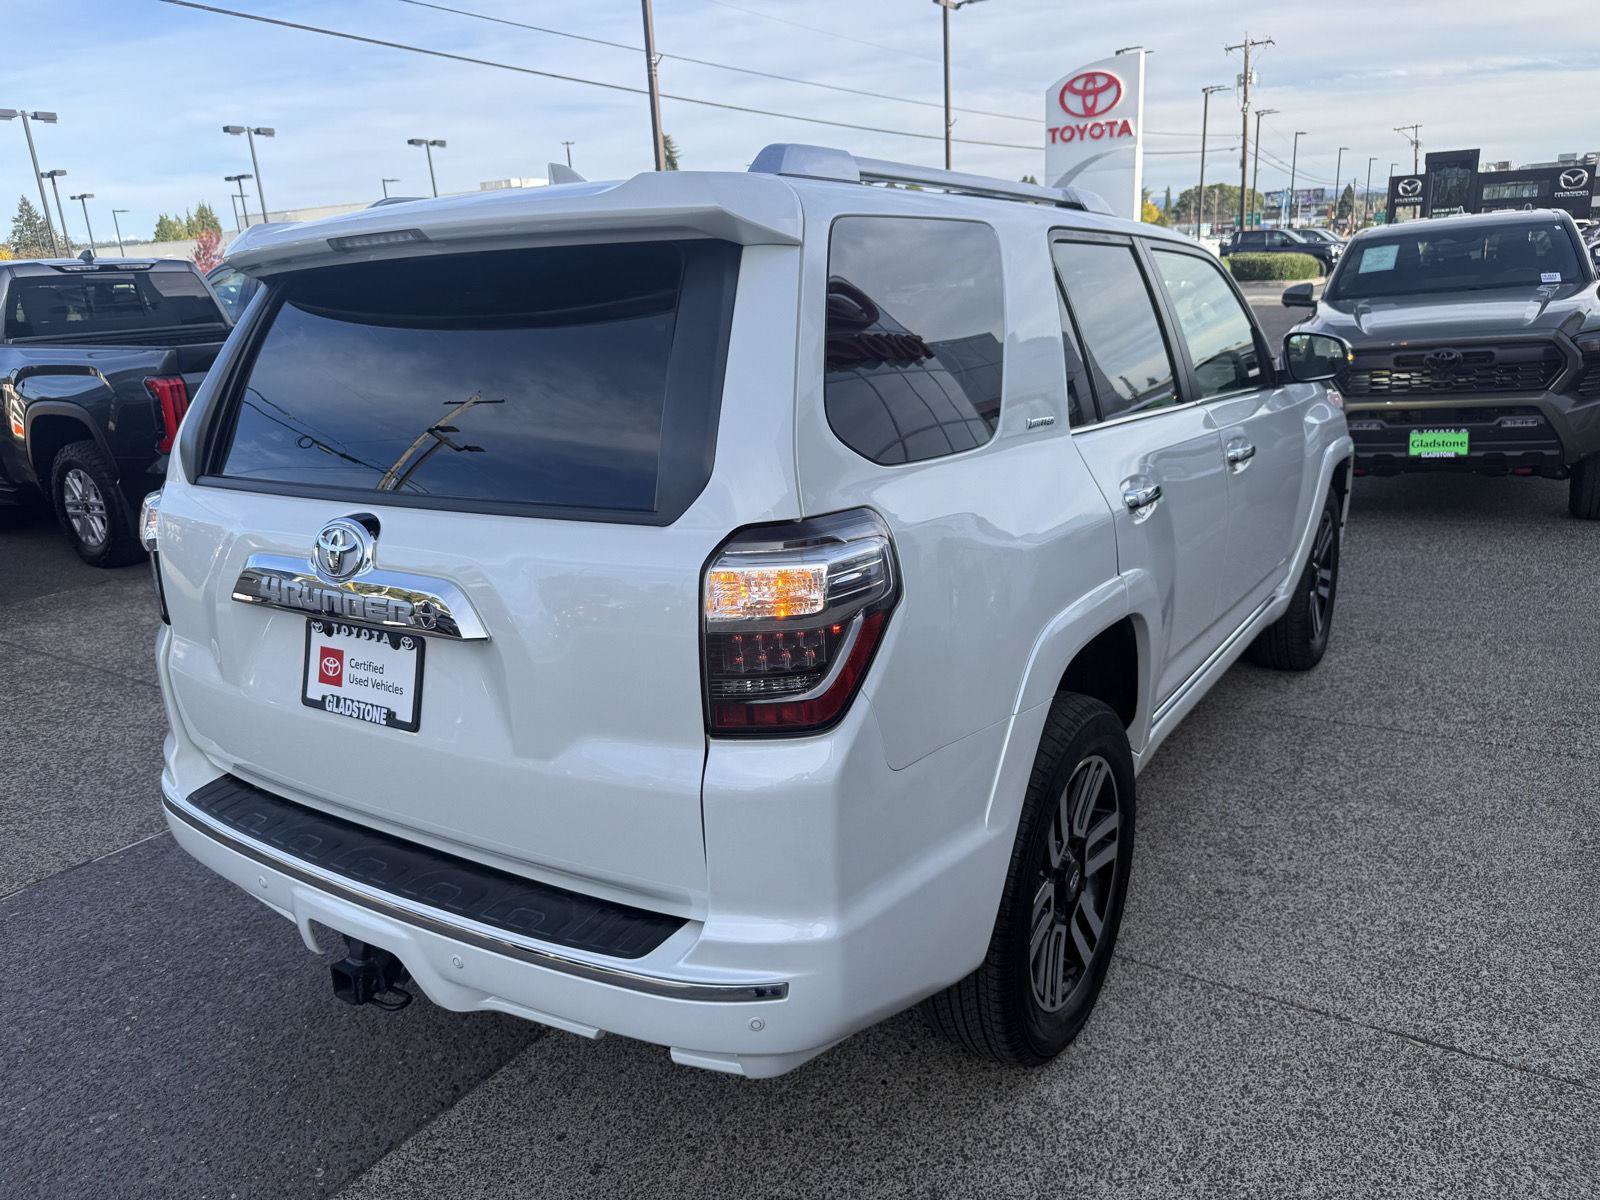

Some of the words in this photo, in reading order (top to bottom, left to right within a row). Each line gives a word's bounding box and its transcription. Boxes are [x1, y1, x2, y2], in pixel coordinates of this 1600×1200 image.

[1047, 119, 1134, 144] TOYOTA
[1411, 439, 1467, 449] Gladstone
[259, 575, 414, 625] 4RUNNER
[331, 623, 391, 645] TOYOTA
[349, 658, 385, 675] Certified
[348, 673, 369, 688] Used
[371, 679, 404, 696] Vehicles
[325, 695, 388, 725] GLADSTONE
